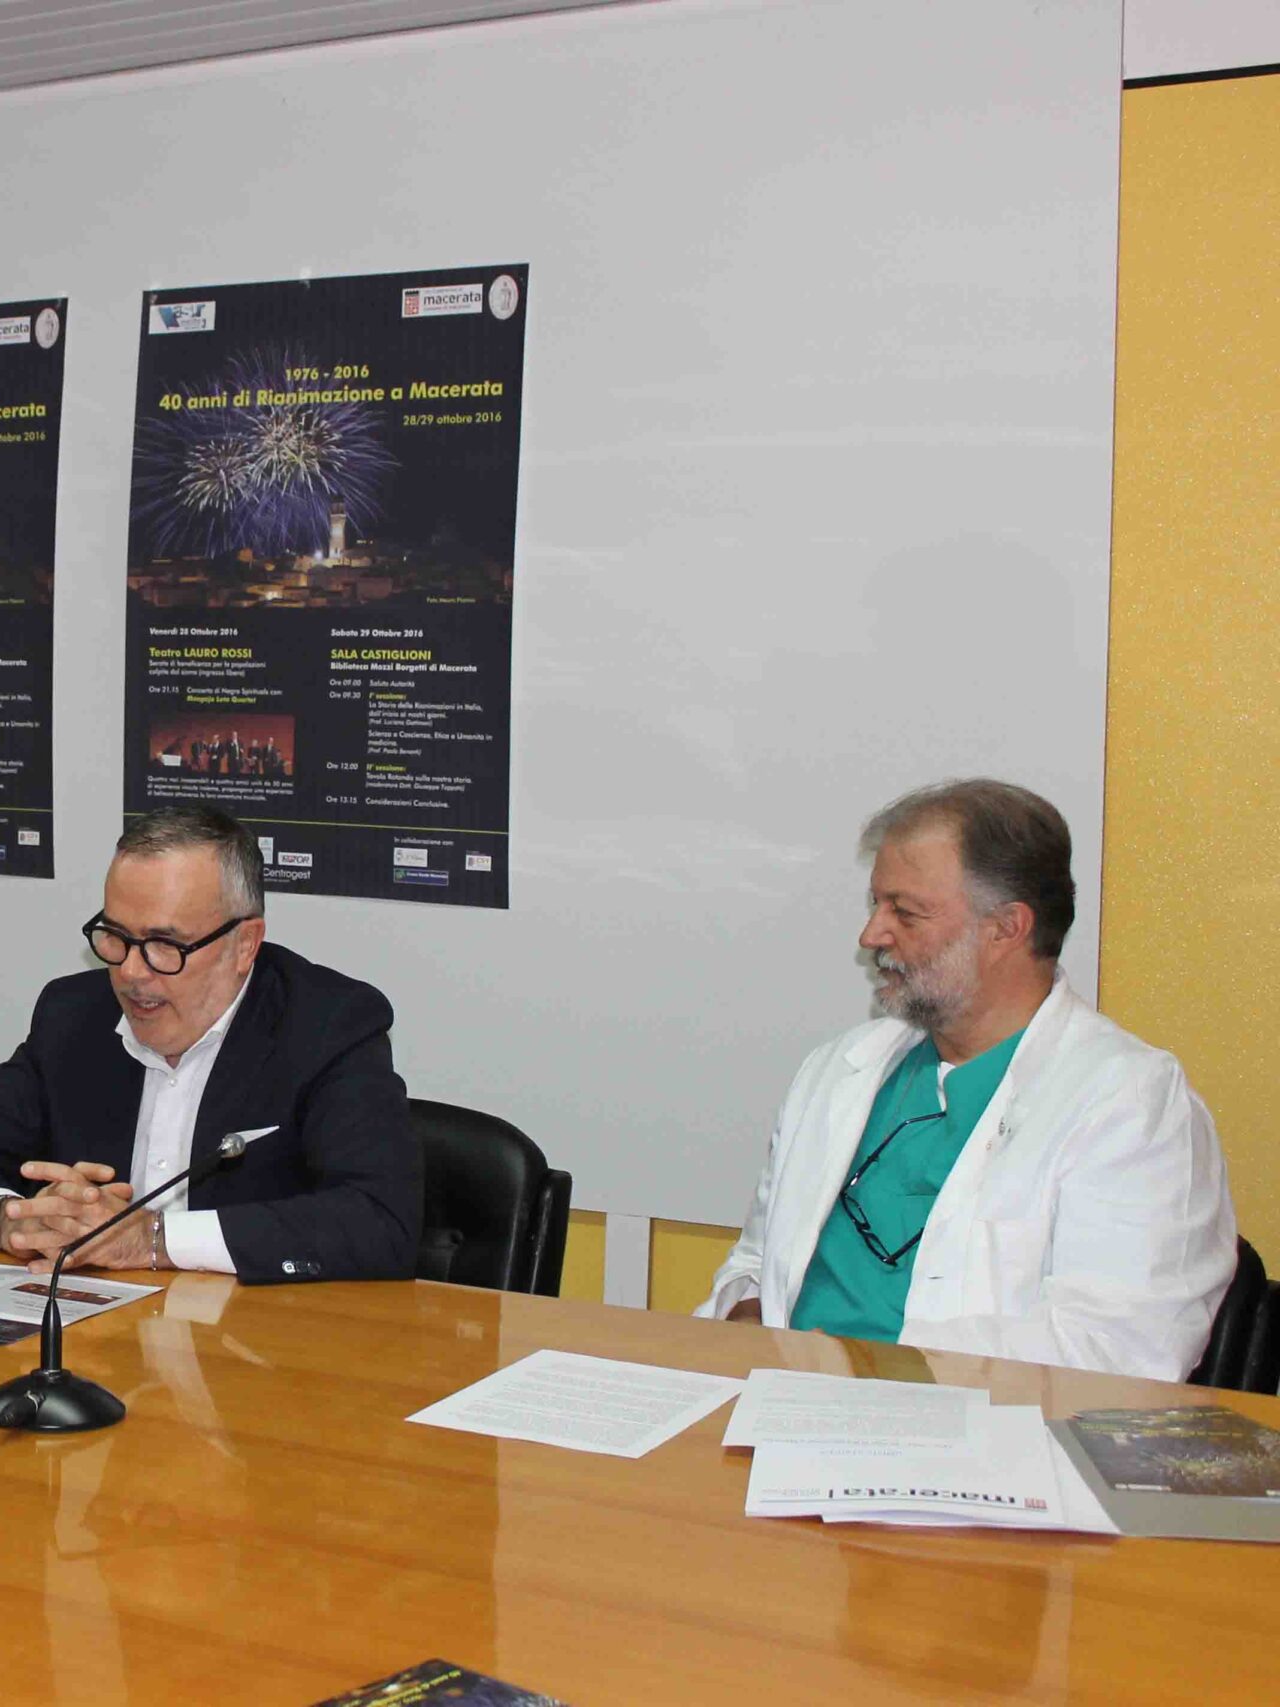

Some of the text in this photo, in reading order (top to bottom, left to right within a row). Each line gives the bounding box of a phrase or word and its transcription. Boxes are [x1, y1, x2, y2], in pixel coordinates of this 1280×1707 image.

[423, 292, 481, 306] macerata
[285, 367, 319, 381] 1976
[334, 365, 369, 379] 2016
[159, 380, 503, 411] 40 anni di Rianimazione a Macerata
[403, 412, 502, 427] 28/29 ottobre 2016
[23, 431, 46, 441] 2016
[149, 627, 178, 635] Venerdì
[220, 628, 238, 636] 2016
[331, 629, 358, 637] Sabato
[360, 629, 370, 637] 29
[372, 629, 401, 637] Ottobre
[149, 647, 252, 658] Teatro LAURO ROSSI
[331, 649, 431, 660] SALA CASTIGLIONI
[330, 662, 477, 673] Biblioteca Mozzi Borgetti di Macerata
[330, 691, 341, 699] Ore
[327, 762, 339, 770] Ore
[326, 796, 338, 804] Ore
